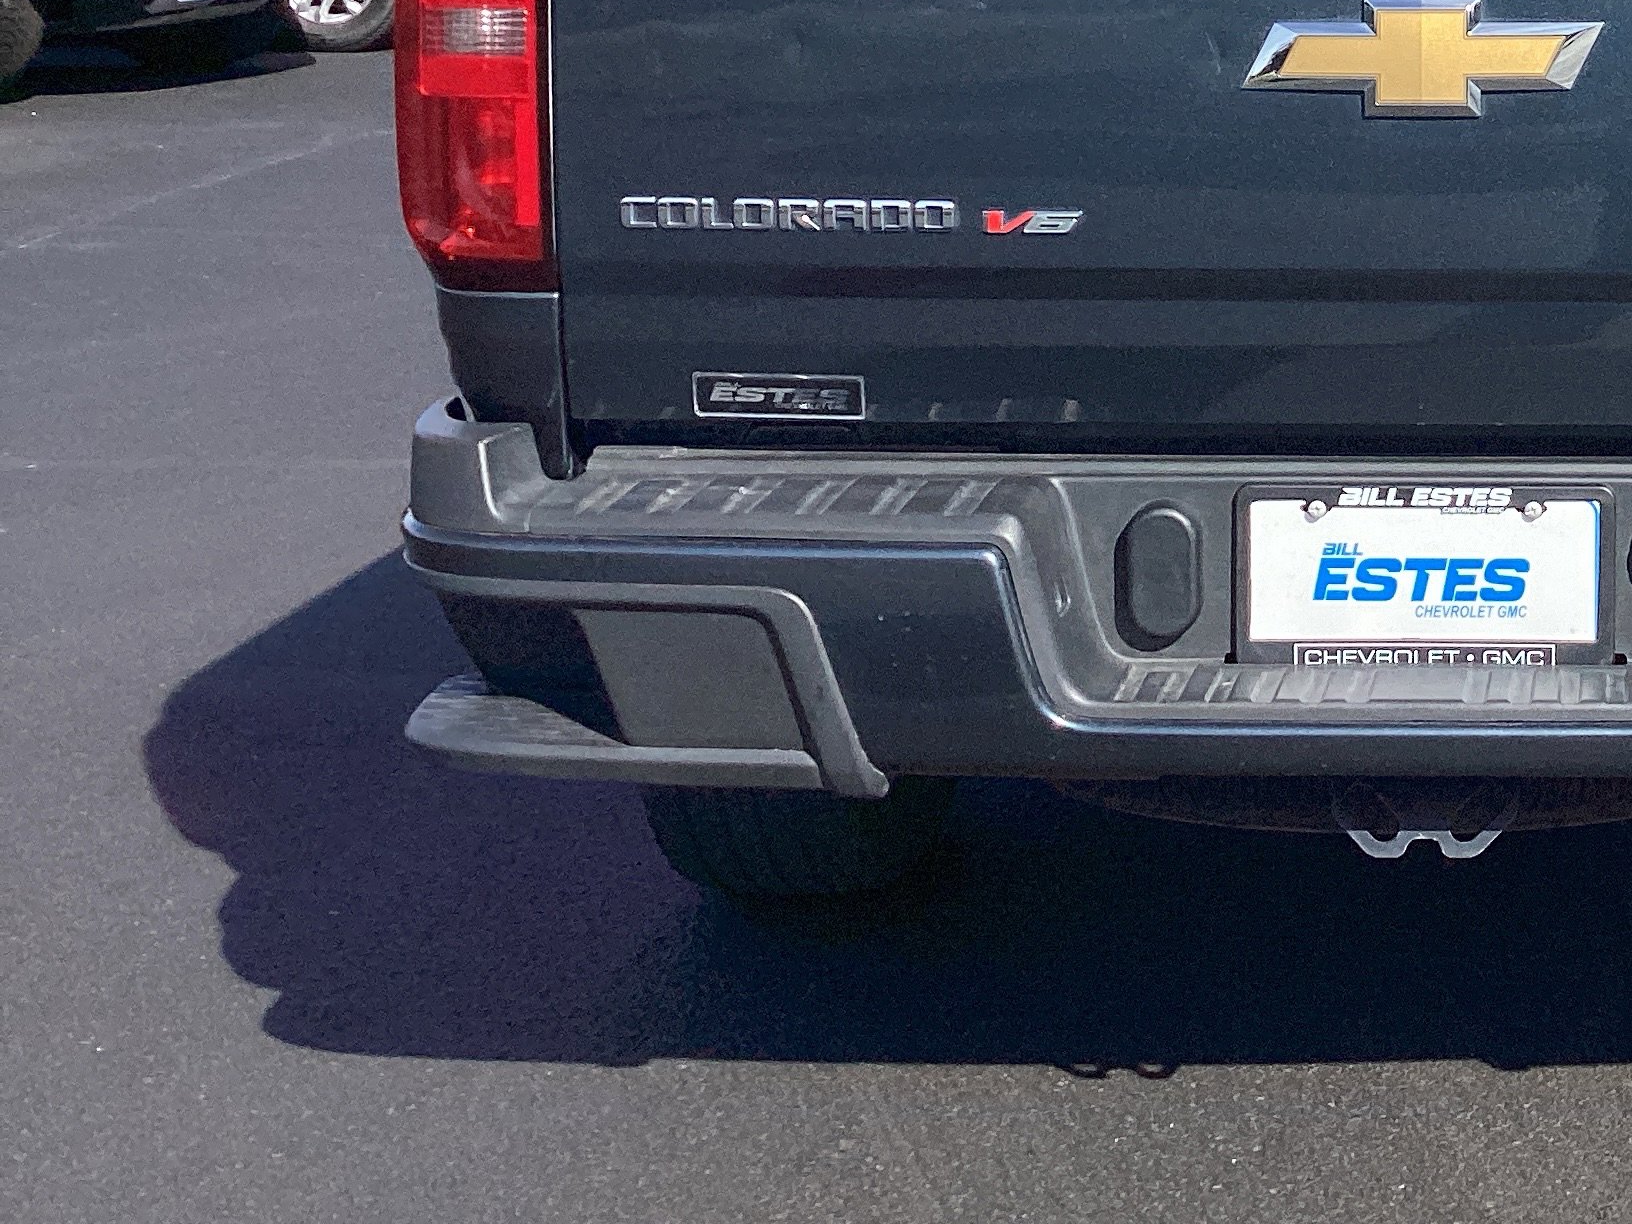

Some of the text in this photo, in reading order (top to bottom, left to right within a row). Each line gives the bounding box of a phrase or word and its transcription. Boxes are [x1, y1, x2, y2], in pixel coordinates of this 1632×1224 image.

[620, 196, 1084, 234] COLORADO V6
[709, 386, 850, 404] ESTES
[1338, 487, 1513, 507] BILL ESTES
[1322, 542, 1364, 556] BILL
[1312, 558, 1531, 602] ESTES
[1415, 605, 1528, 618] CHEVROLET GMC
[1482, 650, 1545, 665] GMC
